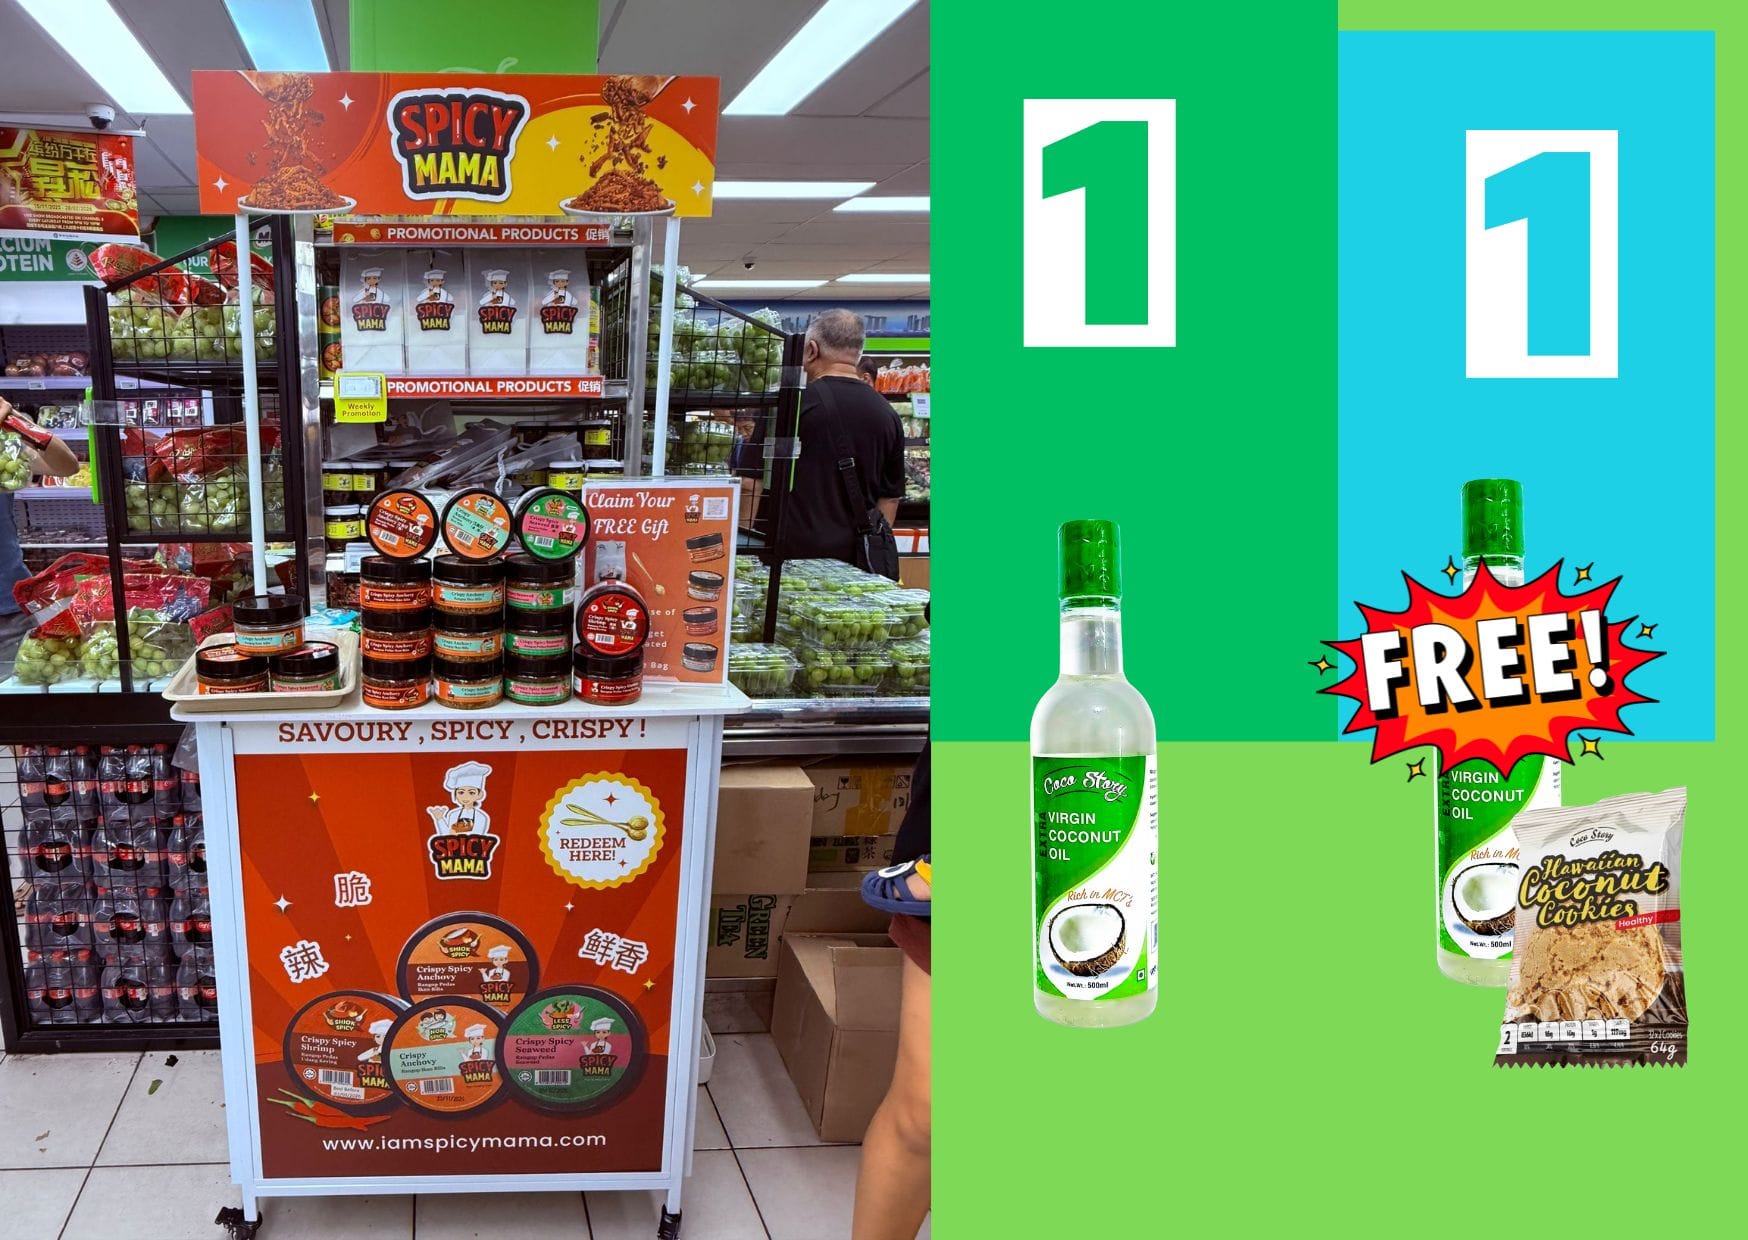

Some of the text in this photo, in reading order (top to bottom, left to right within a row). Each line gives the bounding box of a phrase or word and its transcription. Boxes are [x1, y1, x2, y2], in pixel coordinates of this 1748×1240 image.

[401, 102, 520, 150] SPICY
[414, 152, 499, 188] MAMA
[387, 228, 498, 240] PROMOTIONAL
[501, 228, 579, 240] PRODUCTS
[354, 304, 389, 319] SPICY
[417, 304, 452, 318] SPICY
[480, 307, 515, 321] SPICY
[542, 307, 576, 321] SPICY
[358, 319, 385, 330] MAMA
[422, 317, 449, 329] MAMA
[484, 321, 510, 333] MAMA
[546, 322, 571, 333] MAMA
[388, 381, 601, 394] PROMOTIONAL PRODUCTS 促销
[347, 402, 375, 411] Weekly
[588, 493, 676, 509] Claim Your
[593, 518, 670, 541] FREE Gift
[1452, 770, 1499, 784] VIRGIN
[1044, 771, 1128, 802] Coco Story
[1452, 788, 1525, 802] COCONUT
[1048, 811, 1096, 825] VIRGIN
[1452, 806, 1474, 820] OIL
[1039, 811, 1048, 858] EXTRA
[1049, 830, 1121, 843] COCONUT
[1569, 828, 1614, 847] Coco Story
[434, 838, 494, 859] SPICY
[560, 837, 626, 849] REDEEM
[569, 850, 616, 862] HERE!
[1049, 848, 1071, 861] OIL
[1470, 848, 1491, 861] Rich
[1493, 849, 1503, 857] in
[440, 859, 485, 875] MAMA
[1541, 854, 1640, 880] Hawaiian
[337, 873, 369, 905] 脆
[1519, 868, 1665, 907] Coconut
[1067, 889, 1088, 902] Rich
[1090, 890, 1100, 899] in
[1538, 899, 1635, 927] Cookies
[744, 894, 777, 960] GREEN
[1618, 914, 1654, 929] Healthy
[1490, 939, 1512, 948] 500ml
[582, 931, 646, 972] 鲜香
[284, 943, 325, 979] 辣
[416, 965, 473, 976] Crispy Spicy
[417, 973, 457, 982] Anchovy
[480, 983, 515, 993] SPICY
[1087, 980, 1109, 989] 500ml
[484, 992, 510, 1001] MAMA
[334, 1019, 356, 1027] SHIOK
[301, 1035, 357, 1048] Crispy Spicy
[515, 1037, 574, 1047] Crispy Spicy
[1503, 1030, 1511, 1045] 2
[301, 1043, 335, 1054] Shrimp
[1650, 1041, 1678, 1061] 64g
[399, 1052, 427, 1060] Crispy
[581, 1056, 616, 1067] SPICY
[400, 1059, 438, 1068] Anchovy
[460, 1061, 494, 1073] SPICY
[465, 1072, 491, 1082] MAMA
[584, 1067, 610, 1075] MAMA
[322, 1133, 607, 1153] www.iamspicymama.com
